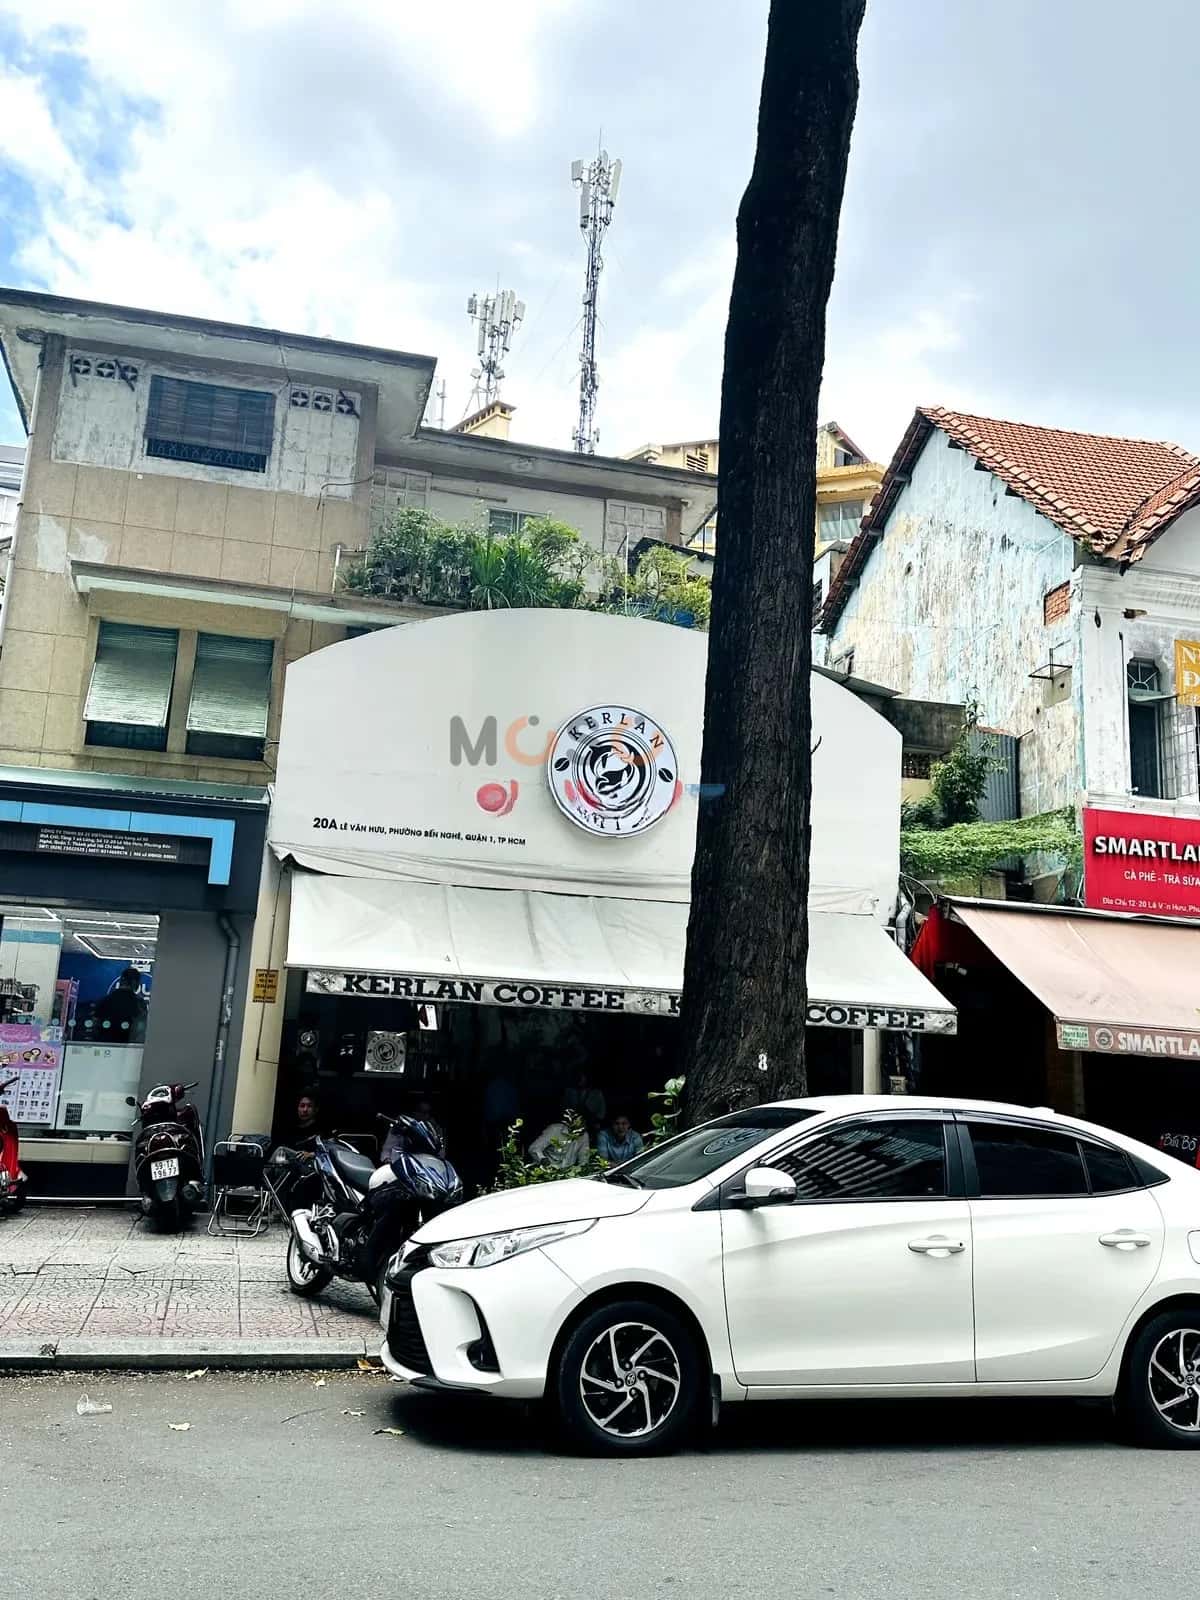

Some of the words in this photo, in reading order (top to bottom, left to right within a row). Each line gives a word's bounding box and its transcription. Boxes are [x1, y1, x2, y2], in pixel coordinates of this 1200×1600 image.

[568, 712, 664, 749] KERLAN
[312, 817, 338, 830] 20A
[498, 836, 506, 844] TP
[508, 837, 526, 846] HCM
[1095, 835, 1200, 862] SMARTLA
[343, 974, 484, 1001] KERLAN
[493, 984, 625, 1010] COFFEE
[806, 1004, 925, 1030] COFFEE
[758, 1053, 768, 1071] 8
